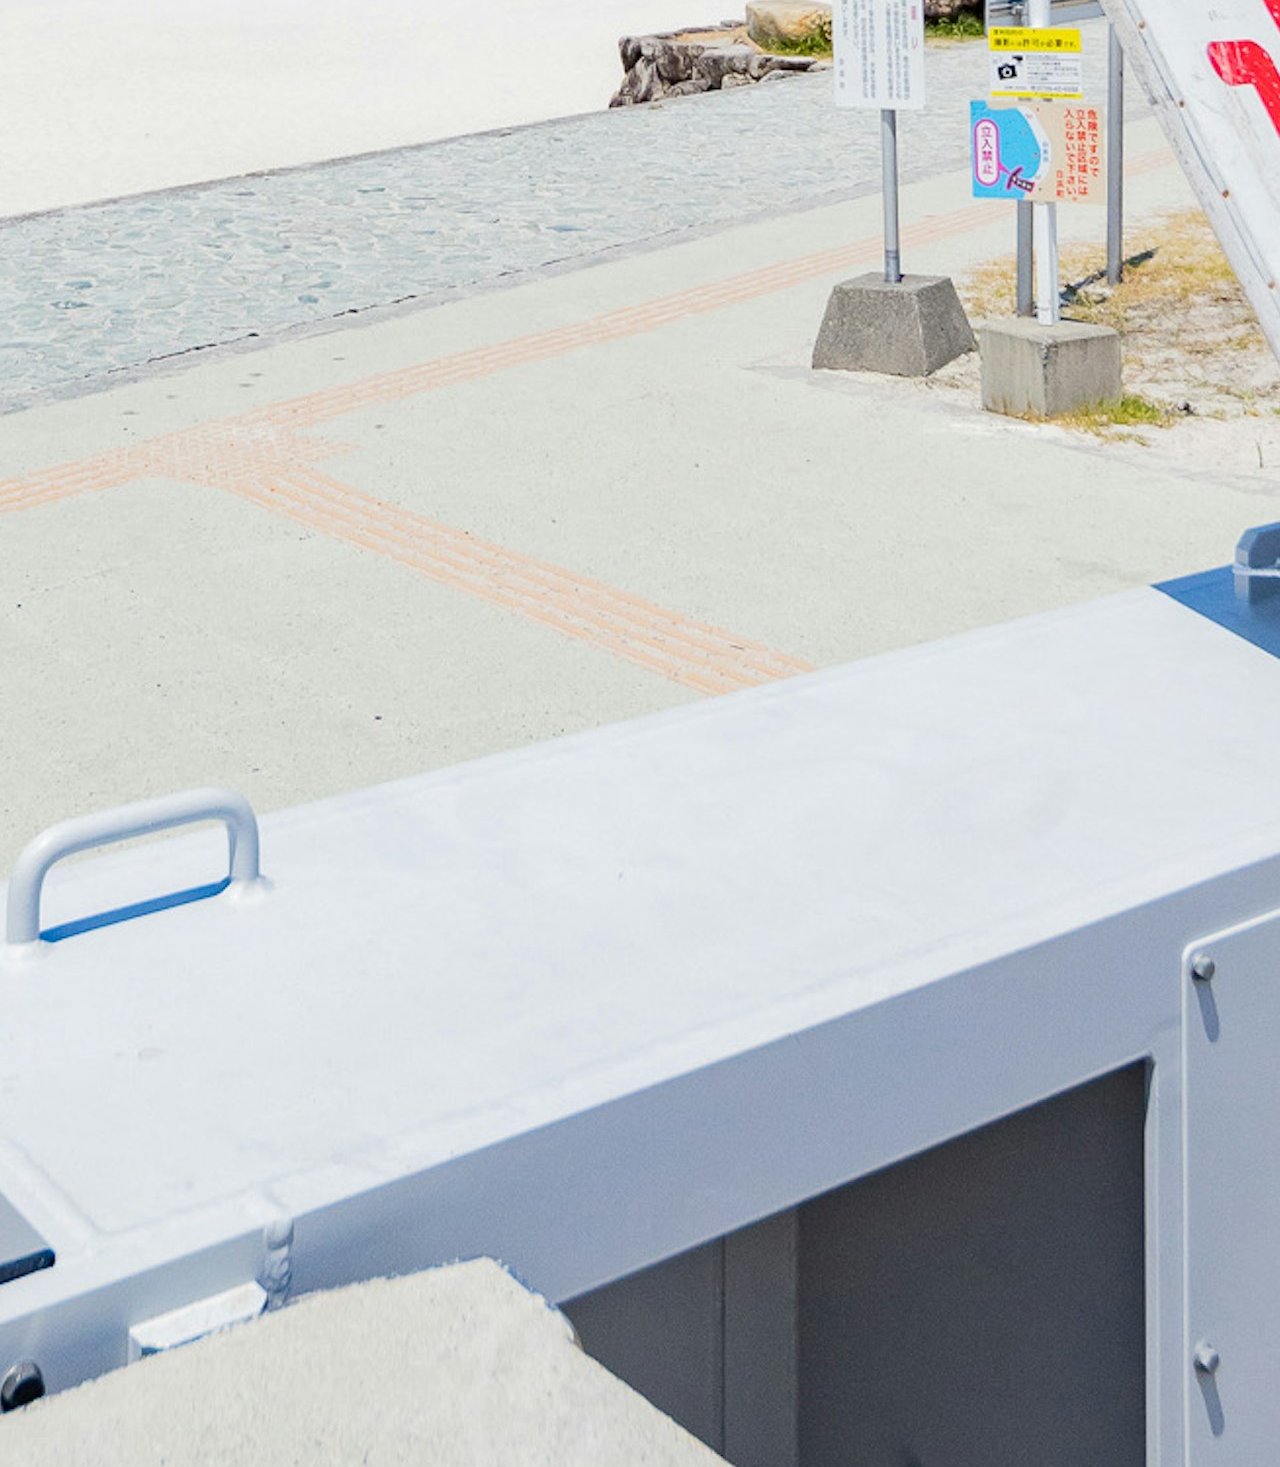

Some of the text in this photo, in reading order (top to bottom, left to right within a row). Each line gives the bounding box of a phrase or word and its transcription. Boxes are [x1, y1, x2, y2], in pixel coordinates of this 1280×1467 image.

[981, 126, 993, 175] 立入禁止
[1076, 109, 1089, 196] 立入禁止区域には
[1088, 110, 1100, 177] 危険ですので
